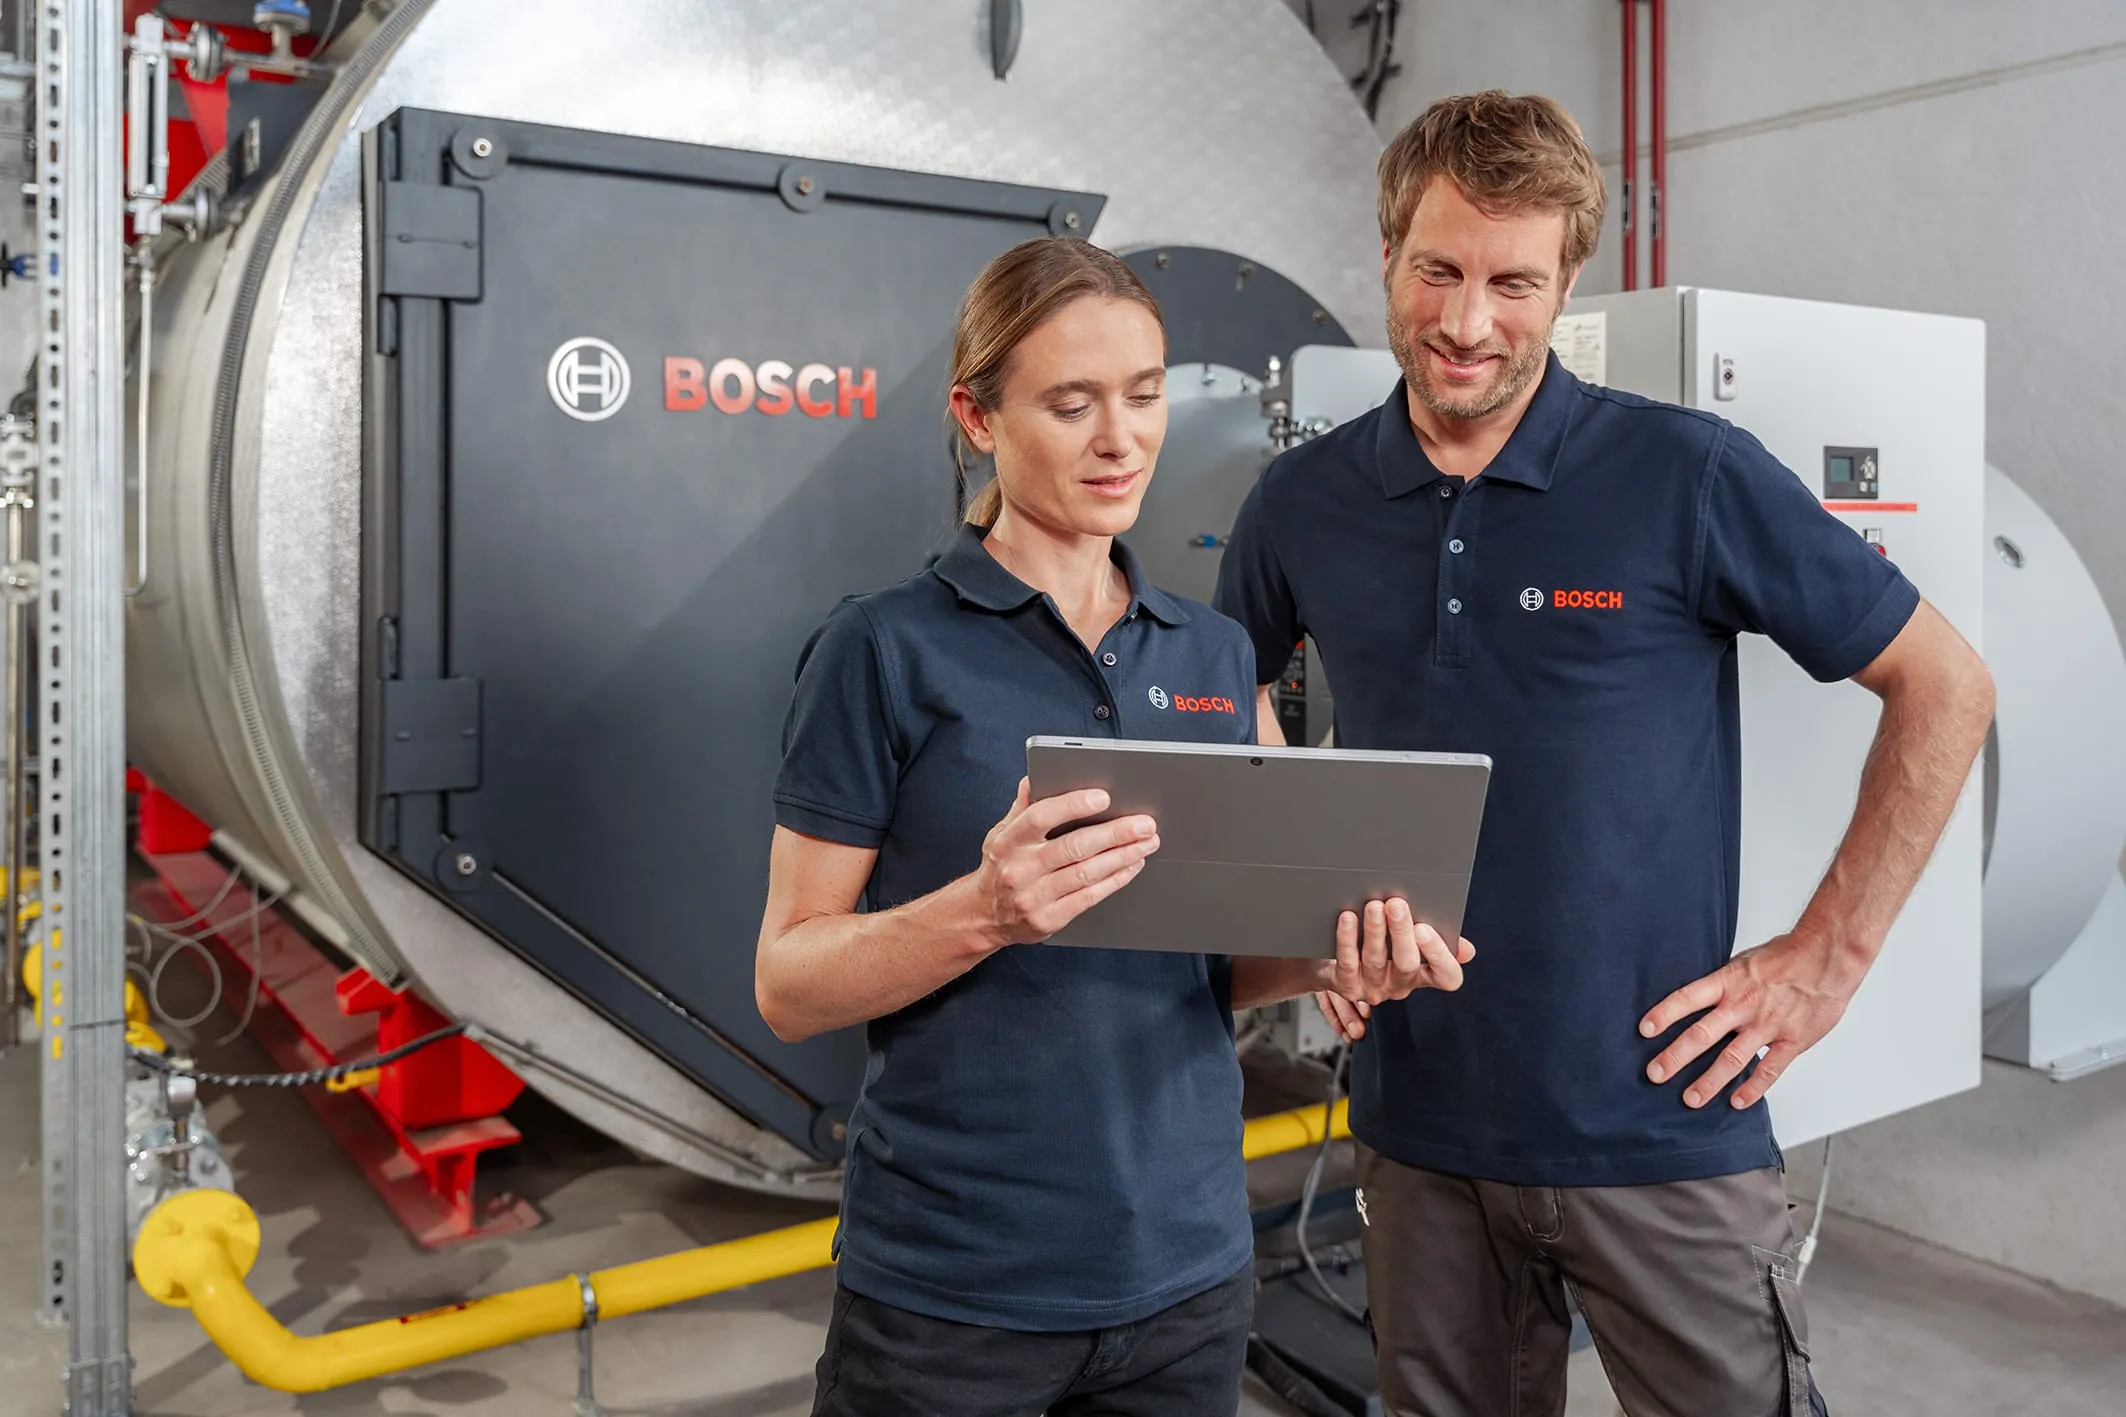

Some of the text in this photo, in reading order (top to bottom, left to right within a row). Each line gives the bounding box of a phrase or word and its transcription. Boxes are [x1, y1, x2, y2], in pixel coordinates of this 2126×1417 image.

[664, 356, 878, 419] BOSCH
[1553, 589, 1623, 609] BOSCH
[1173, 694, 1235, 714] BOSCH
